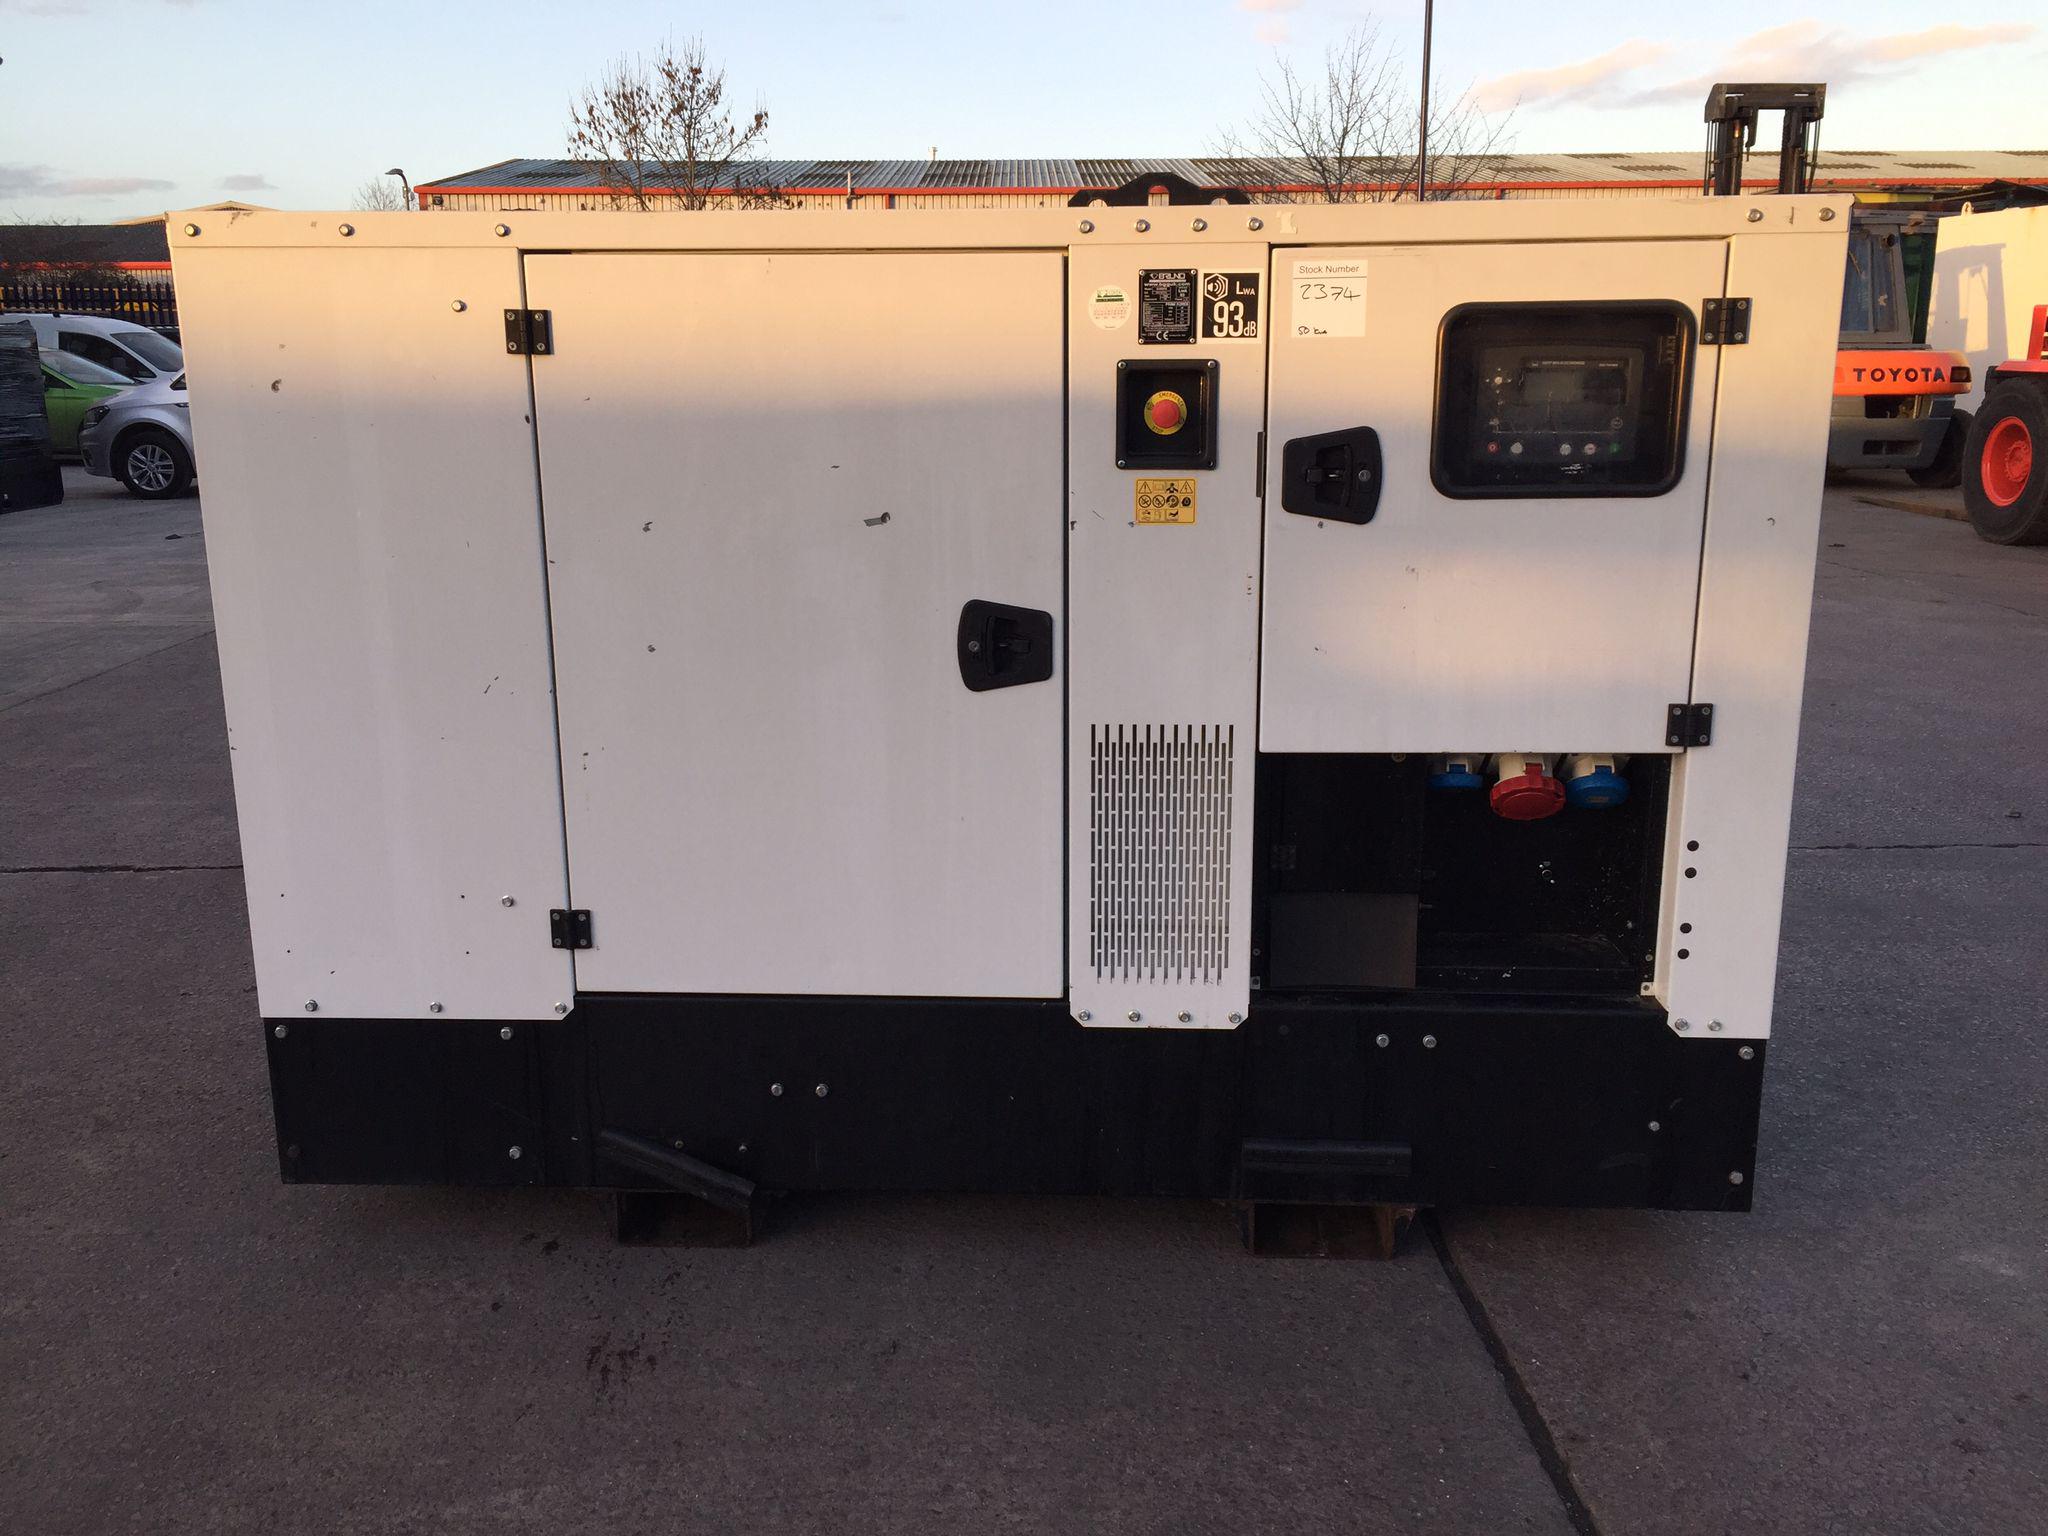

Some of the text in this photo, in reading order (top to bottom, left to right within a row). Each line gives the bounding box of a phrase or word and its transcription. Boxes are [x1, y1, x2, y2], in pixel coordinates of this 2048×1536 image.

[1299, 265, 1359, 274] Stock Number
[1300, 283, 1361, 302] 2374
[1853, 367, 1946, 382] TOYOTA
